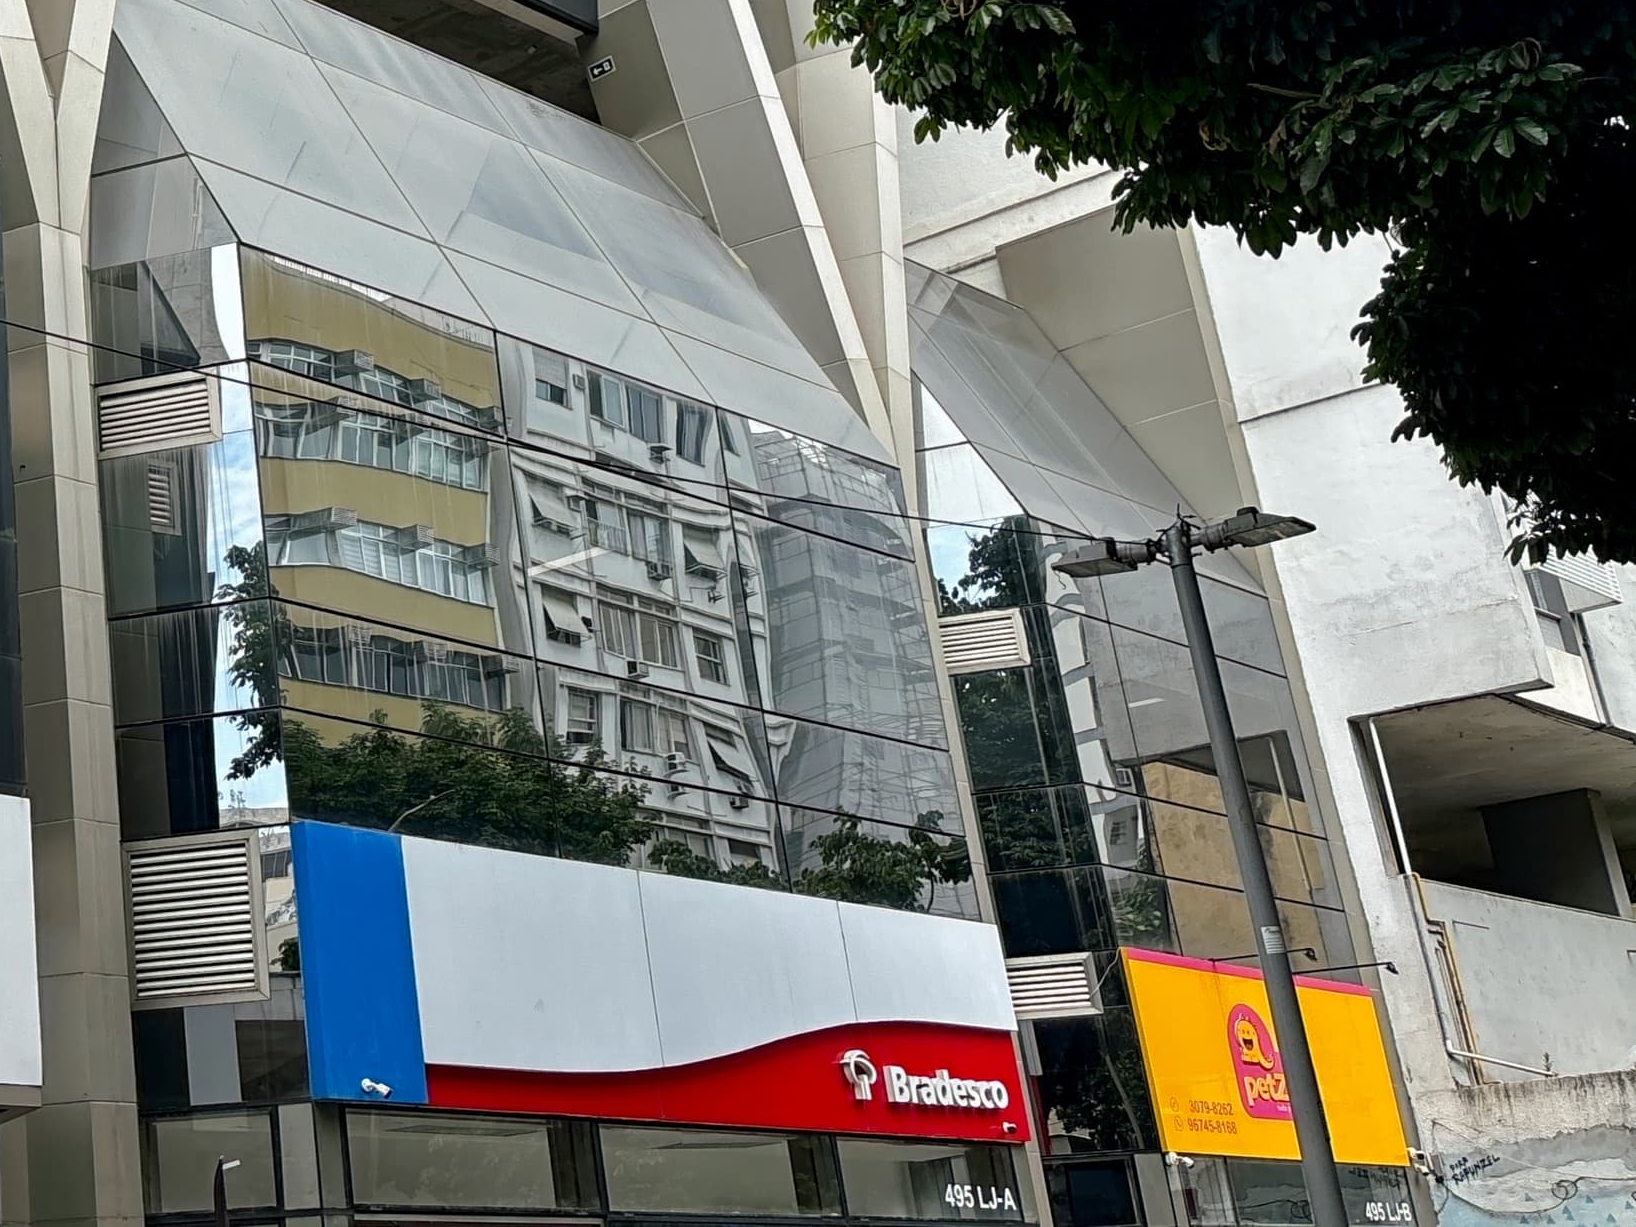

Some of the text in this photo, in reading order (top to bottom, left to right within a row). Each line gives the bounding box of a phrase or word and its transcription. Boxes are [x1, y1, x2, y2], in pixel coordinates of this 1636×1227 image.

[883, 1065, 1009, 1109] Bradesco
[945, 1184, 975, 1208] 495
[1365, 1202, 1385, 1221] 495
